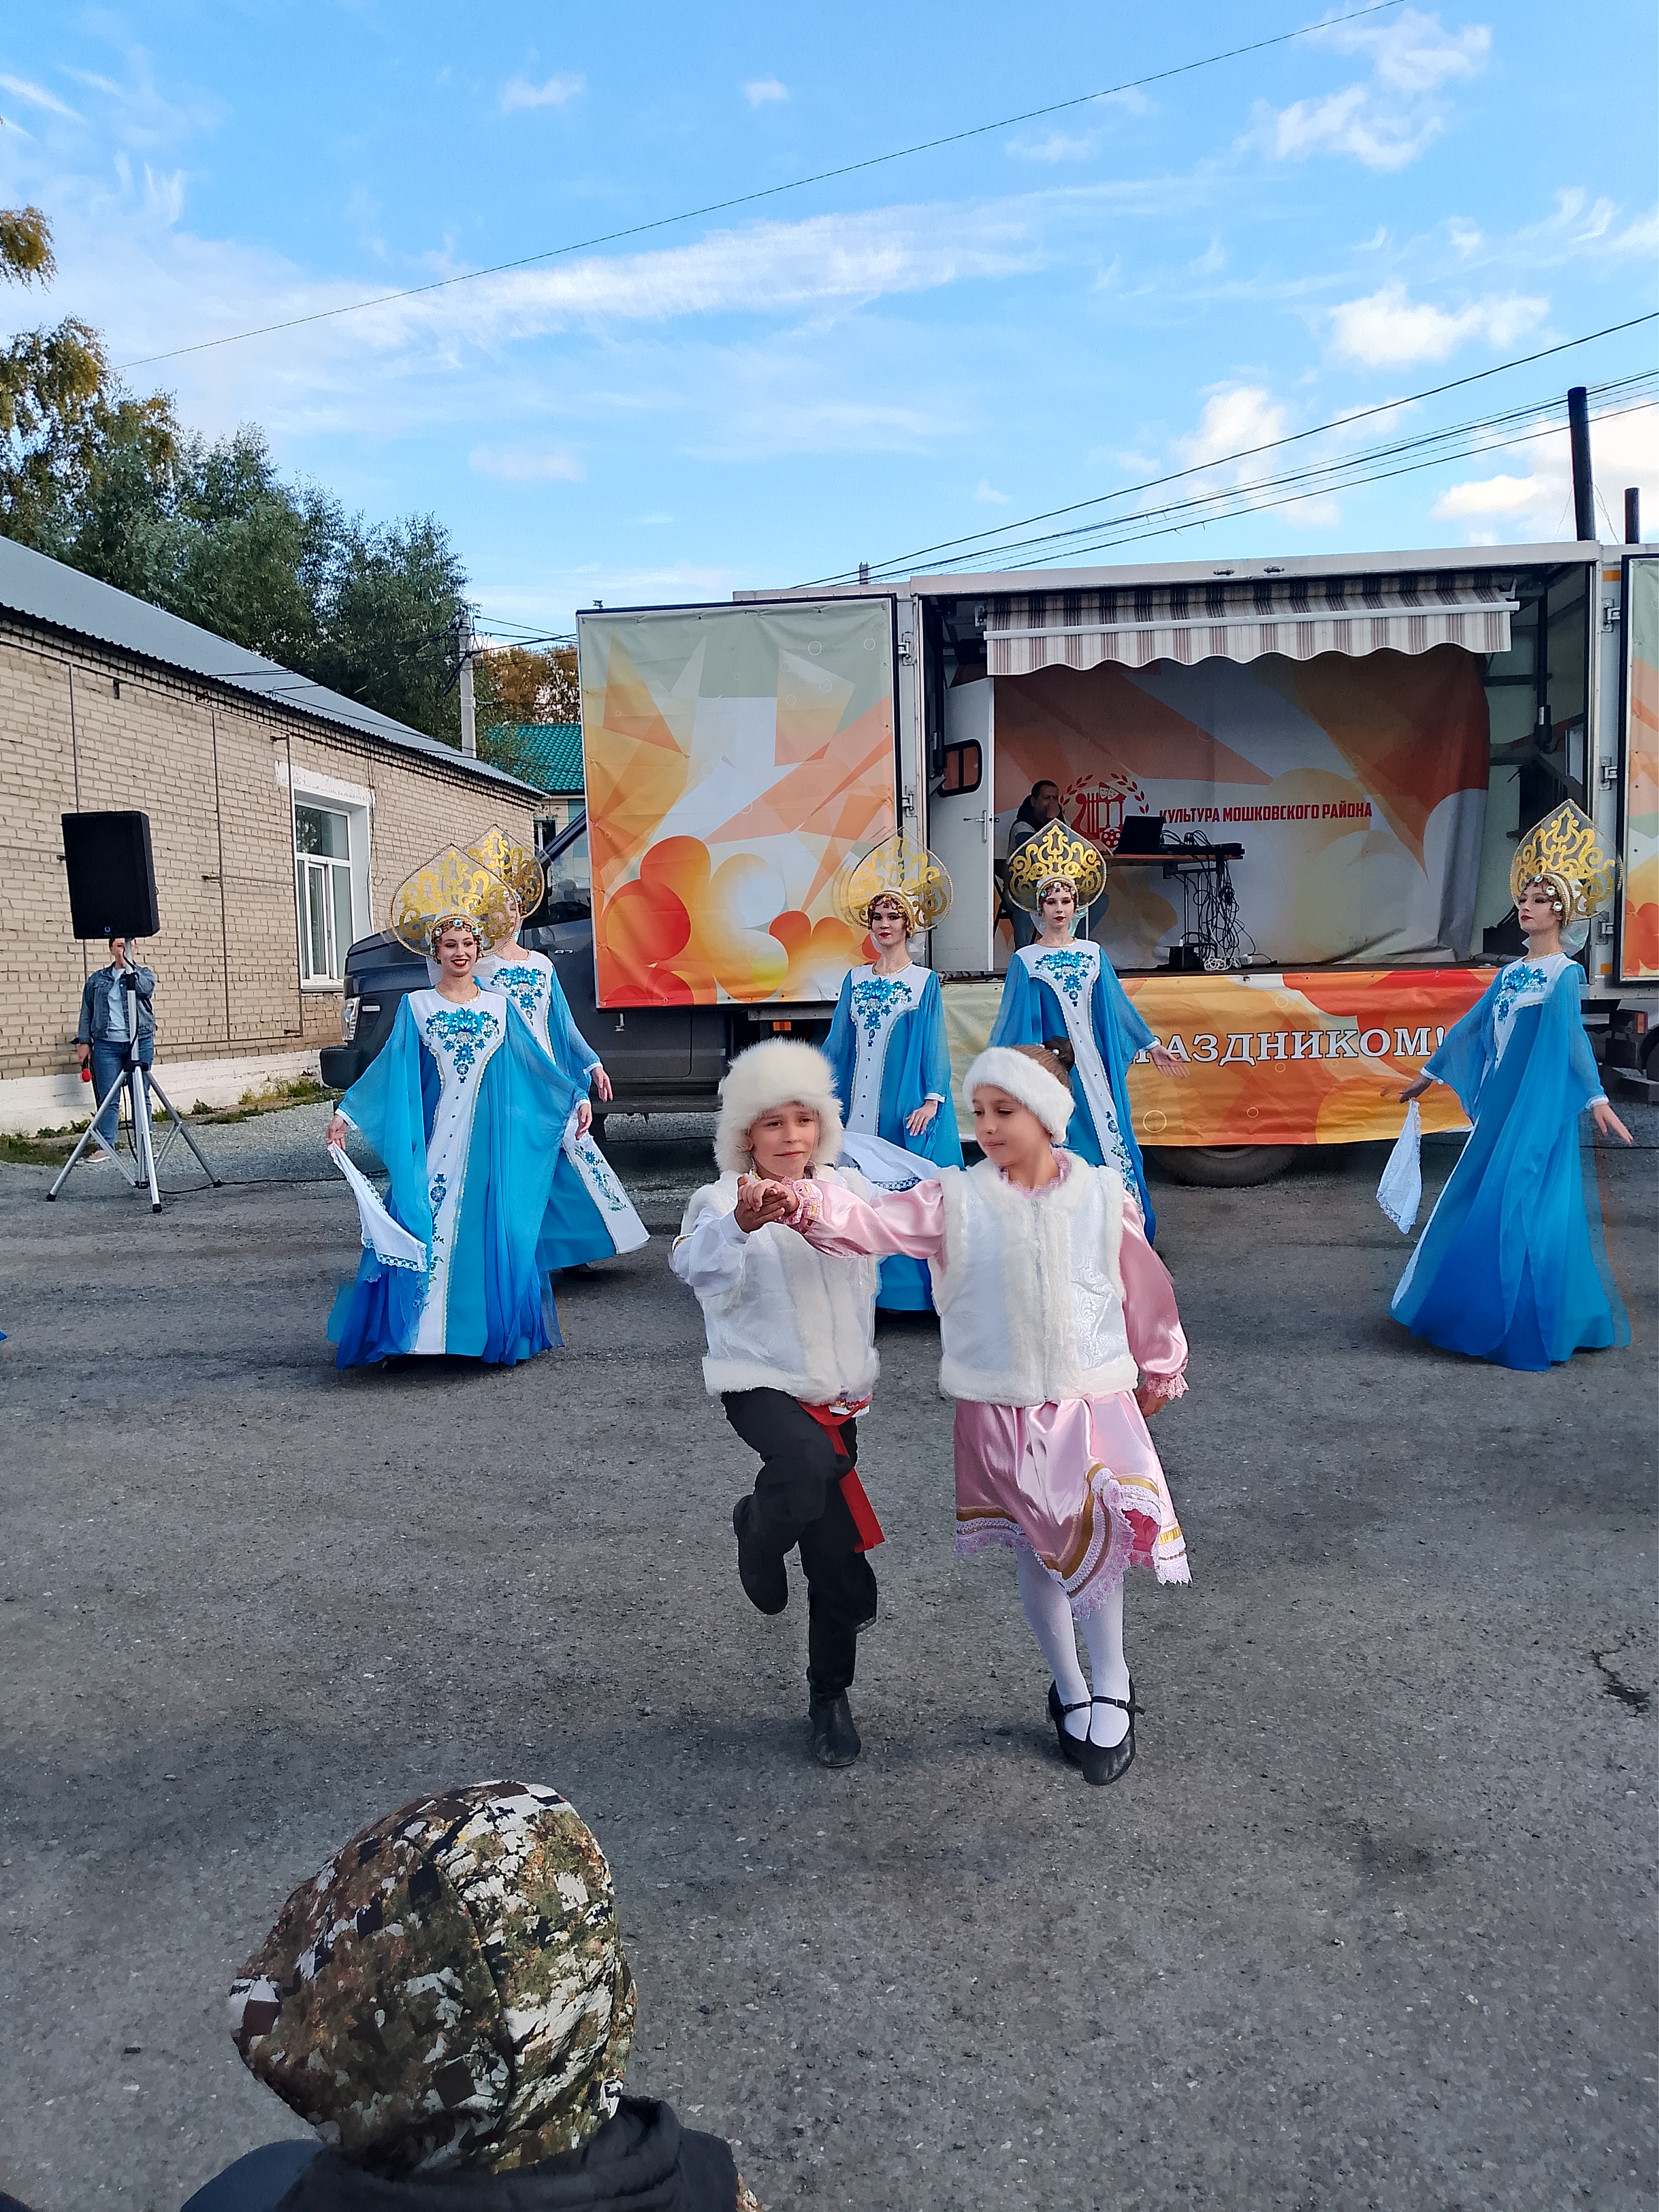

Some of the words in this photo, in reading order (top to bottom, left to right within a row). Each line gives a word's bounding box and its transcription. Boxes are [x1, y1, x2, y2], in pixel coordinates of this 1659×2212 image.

[1159, 807, 1220, 824] КУЛЬТУРА
[1222, 804, 1319, 822] МОШКОВСКОГО
[1322, 800, 1372, 819] РАЙОНА
[1131, 1026, 1445, 1067] РАЗДНИКОМ!
